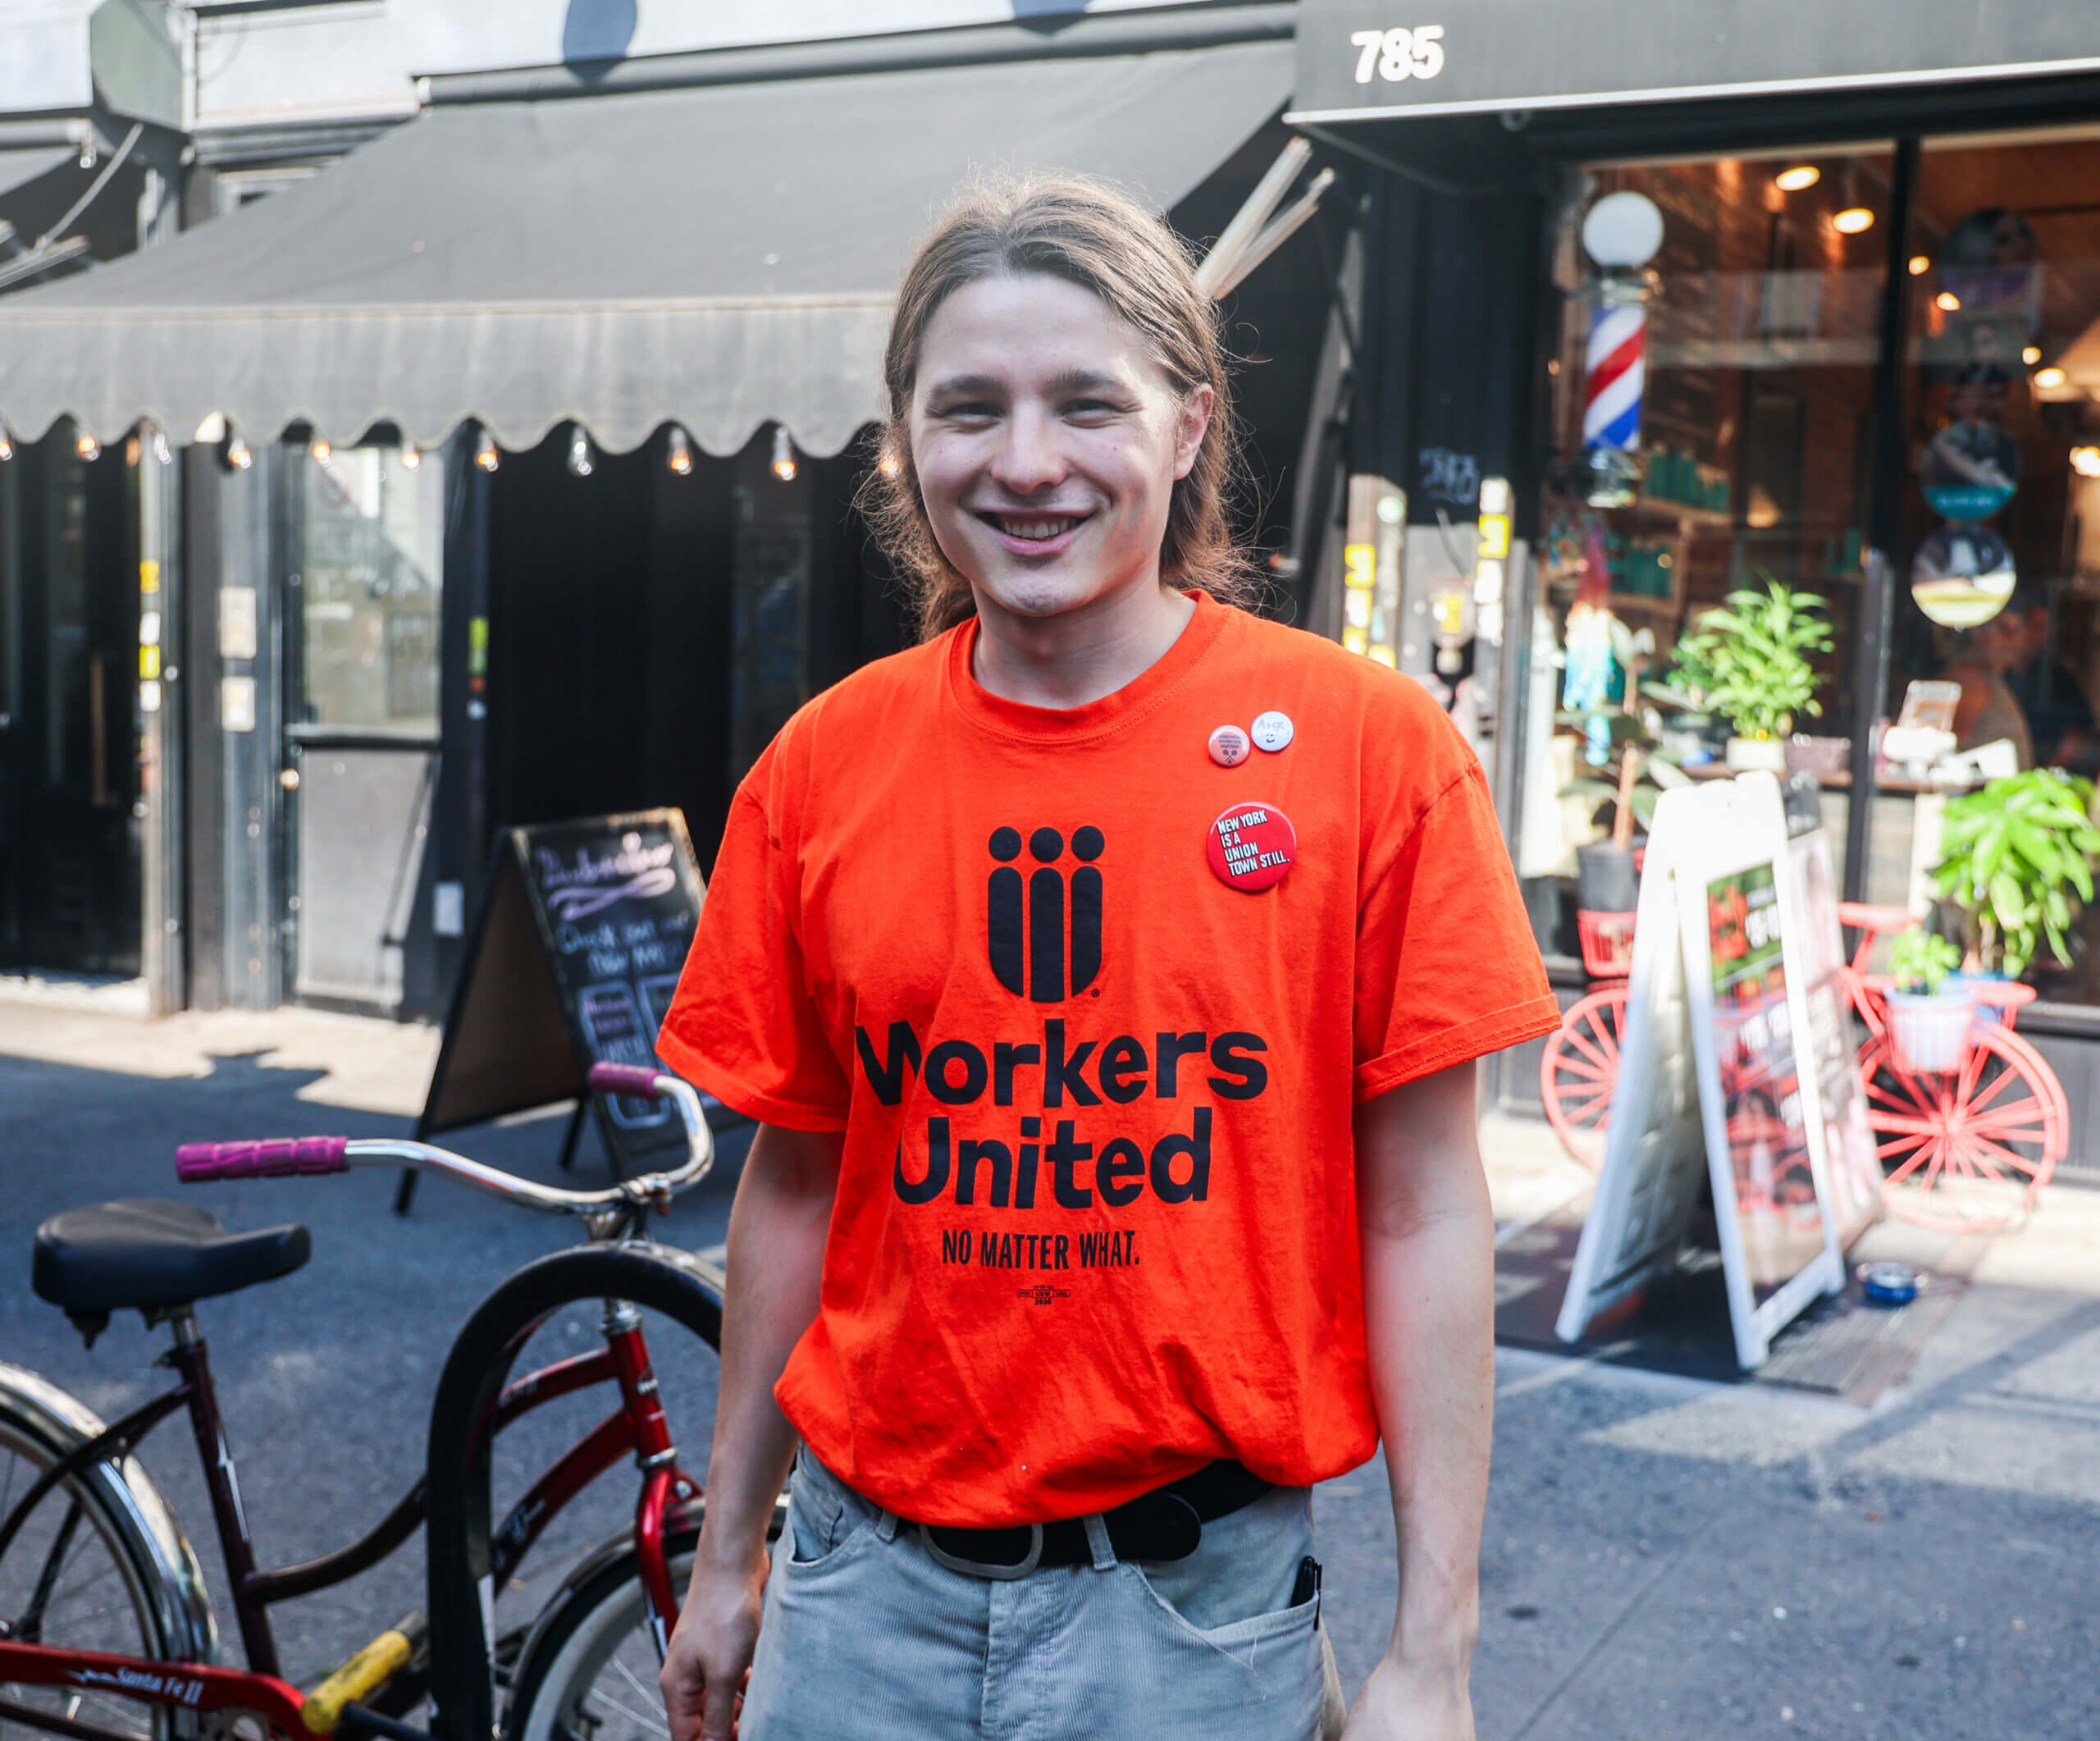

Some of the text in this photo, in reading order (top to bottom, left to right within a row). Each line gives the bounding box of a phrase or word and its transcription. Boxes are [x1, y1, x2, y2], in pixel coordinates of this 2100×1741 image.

[1350, 24, 1445, 84] 785
[1217, 809, 1268, 834] NEW YORK
[1221, 831, 1242, 848] IS A
[1224, 842, 1259, 863] UNION
[1227, 850, 1290, 877] TOWN STILL.
[855, 1018, 1268, 1108] Workers
[893, 1107, 1212, 1209] United
[942, 1230, 1139, 1270] NO MATTER WHAT.
[116, 1666, 204, 1704] Santa Fe II
